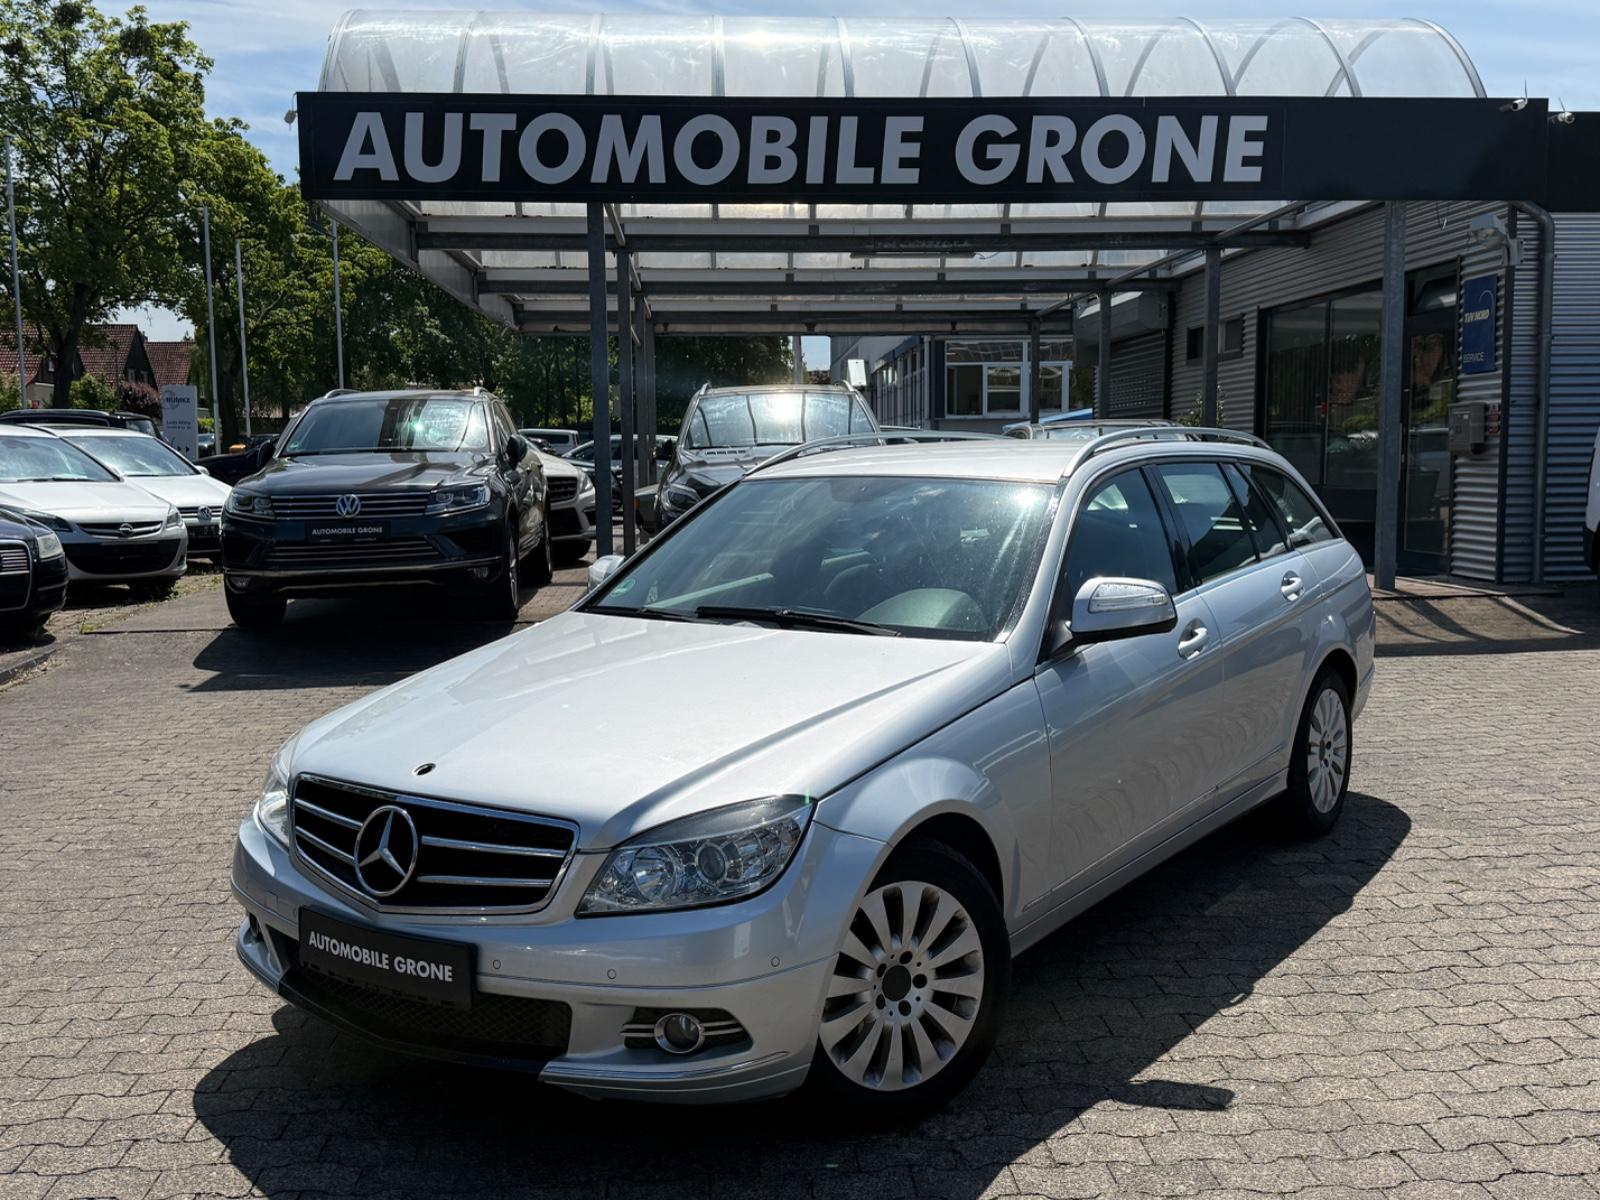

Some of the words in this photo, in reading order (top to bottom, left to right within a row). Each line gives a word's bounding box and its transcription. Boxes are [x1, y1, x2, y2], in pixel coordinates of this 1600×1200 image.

[333, 111, 925, 186] AUTOMOBILE
[954, 113, 1268, 186] GRONE
[1474, 309, 1490, 320] NORD
[1463, 352, 1484, 363] SERVICE
[312, 527, 355, 535] AUTOMOBILE
[357, 526, 383, 534] GRONE
[308, 930, 390, 970] AUTOMOBILE
[393, 955, 453, 982] GRONE
